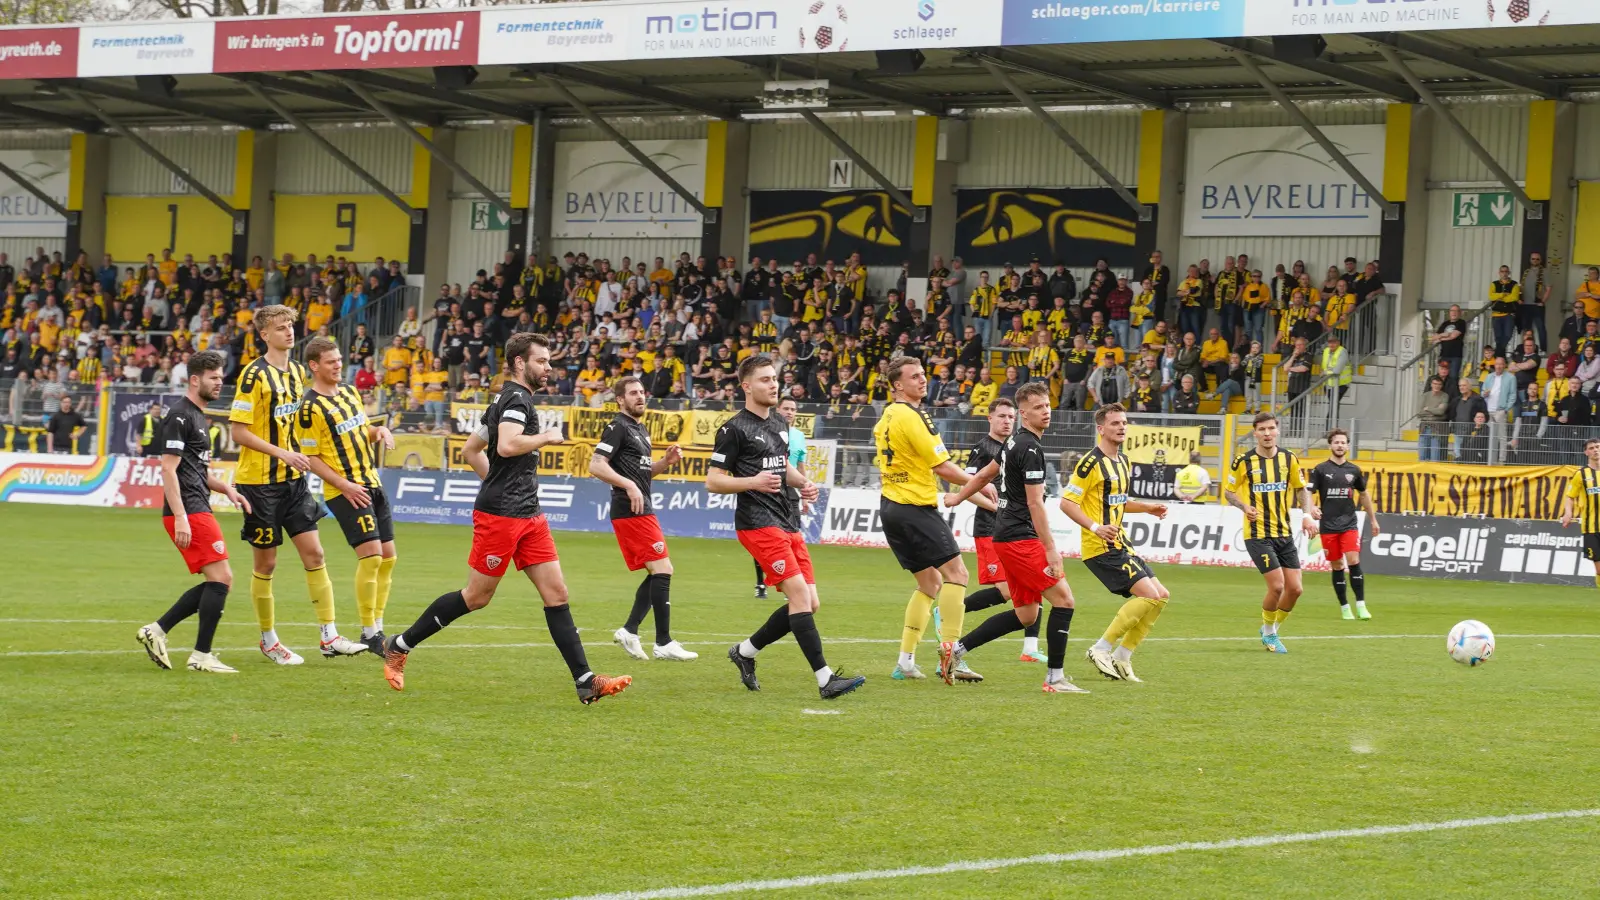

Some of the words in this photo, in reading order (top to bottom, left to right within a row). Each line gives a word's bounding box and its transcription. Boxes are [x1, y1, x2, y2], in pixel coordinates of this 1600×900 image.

[1031, 0, 1221, 20] schlaeger.com/karriere
[1292, 14, 1317, 26] FOR
[1324, 12, 1354, 24] MAN
[1360, 10, 1390, 23] AND
[1396, 7, 1460, 22] MACHINE
[497, 18, 605, 34] Formentechnik
[645, 7, 777, 34] motion
[92, 35, 185, 48] Formentechnik
[227, 35, 250, 49] Wir
[251, 33, 309, 51] bringen's
[311, 32, 325, 47] in
[334, 20, 464, 61] Topform!
[547, 33, 613, 47] Bayreuth
[893, 26, 958, 40] schlaeger
[645, 40, 665, 51] FOR
[670, 39, 694, 50] MAN
[699, 37, 722, 49] AND
[727, 35, 777, 48] MACHINE
[137, 48, 194, 60] Bayreuth
[1201, 183, 1370, 219] BAYREUTH
[335, 203, 356, 252] 9
[19, 467, 45, 485] SW
[46, 470, 84, 487] color
[668, 491, 700, 510] AM
[1326, 487, 1349, 496] BAUER
[357, 514, 376, 533] 13
[253, 528, 274, 545] 23
[1370, 527, 1490, 567] capelli
[1122, 556, 1143, 579] 21
[1260, 553, 1271, 568] 7
[1420, 559, 1484, 574] SPORT
